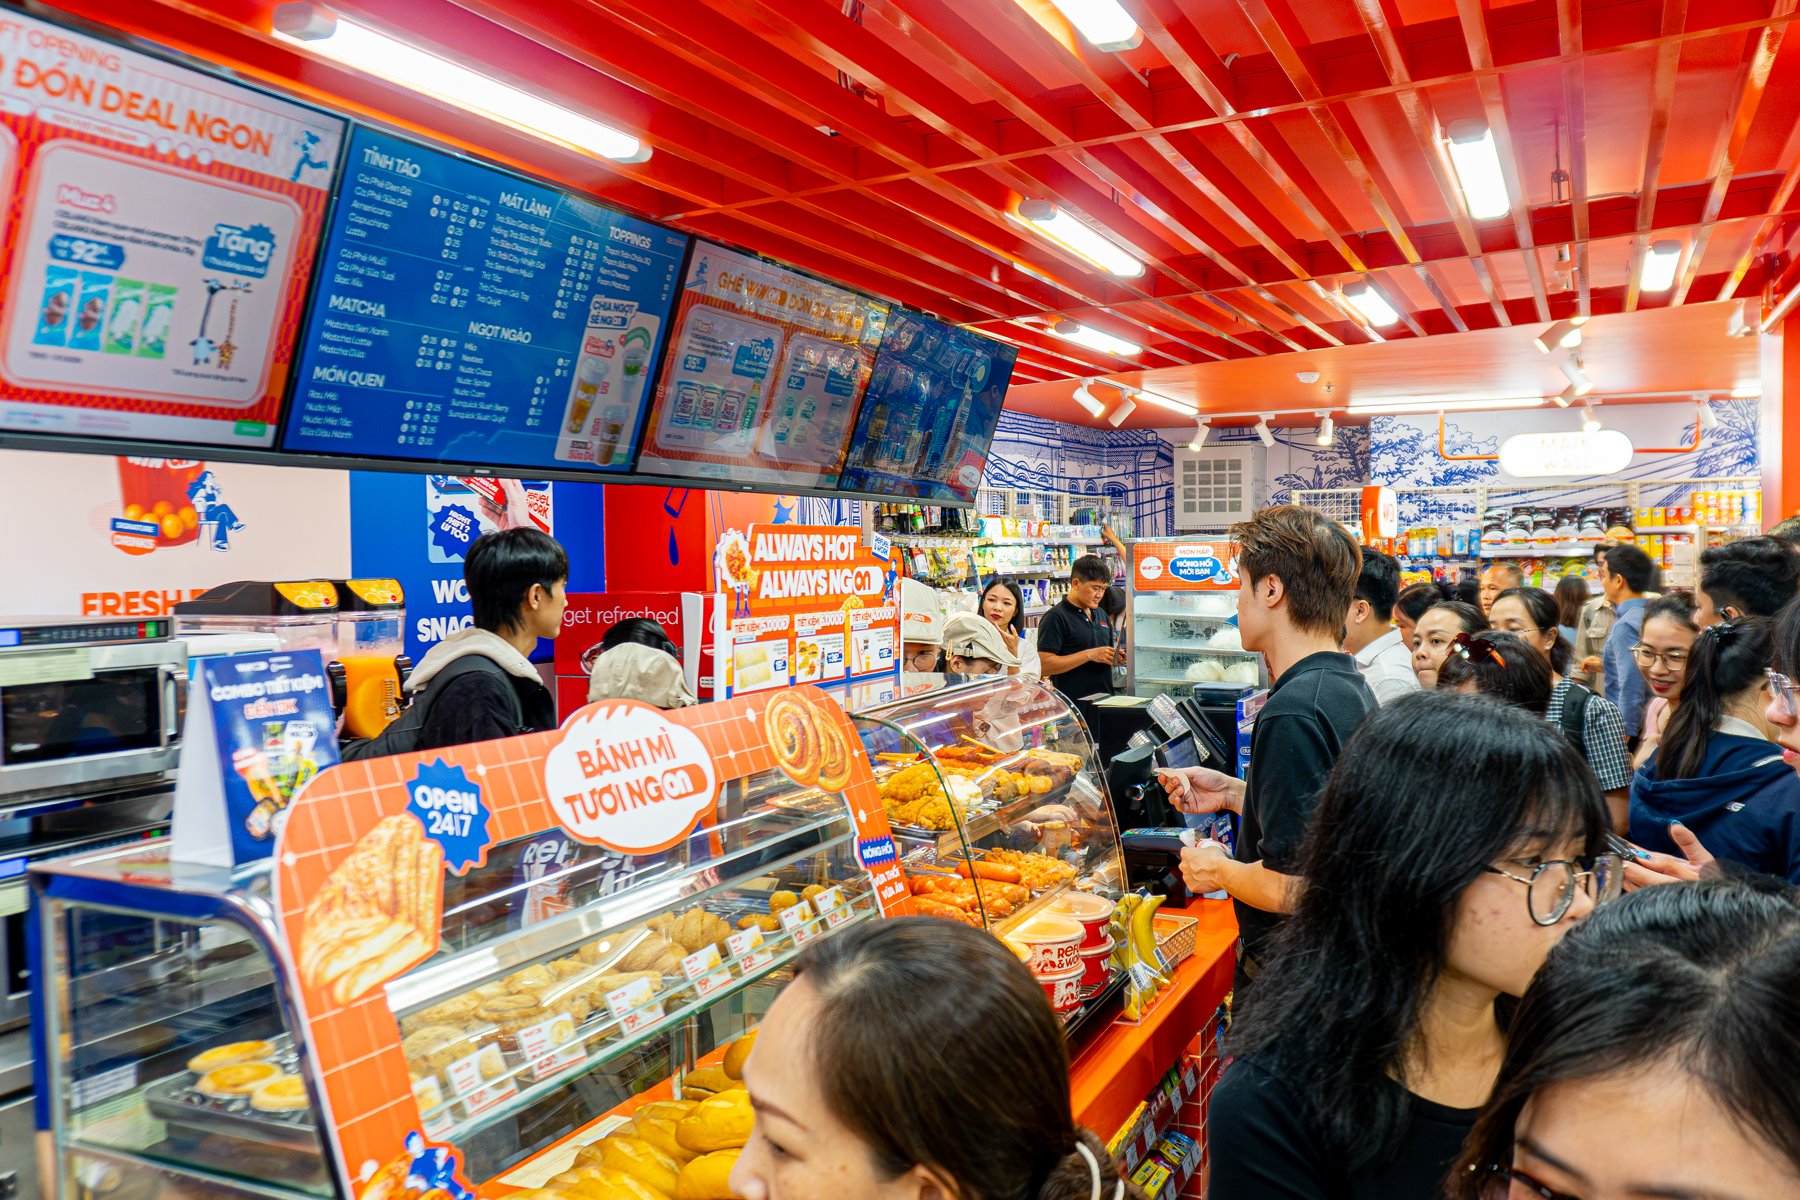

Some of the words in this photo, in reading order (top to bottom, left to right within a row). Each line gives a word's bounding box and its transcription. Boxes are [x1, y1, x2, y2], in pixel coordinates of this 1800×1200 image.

[28, 30, 121, 72] OPENING
[14, 57, 94, 107] ĐÓN
[101, 83, 179, 132] DEAL
[185, 108, 274, 157] NGON
[364, 147, 395, 172] TỈNH
[499, 190, 523, 210] MÁT
[523, 198, 552, 219] LÀNH
[216, 225, 271, 262] Tặng
[609, 227, 652, 249] TOPPINGS
[718, 271, 744, 293] GHÉ
[329, 295, 386, 318] MATCHA
[468, 321, 501, 342] NGỌT
[501, 325, 532, 344] NGÀO
[313, 362, 347, 383] MÓN
[348, 371, 385, 390] QUEN
[448, 510, 472, 525] NIGHT
[451, 526, 469, 542] TOO
[754, 533, 824, 562] ALWAYS
[825, 535, 857, 561] HOT
[759, 569, 828, 599] ALWAYS
[562, 610, 592, 627] get
[596, 605, 679, 625] refreshed
[211, 682, 266, 701] COMBO
[576, 738, 646, 779] BÁNH
[649, 726, 677, 761] MÌ
